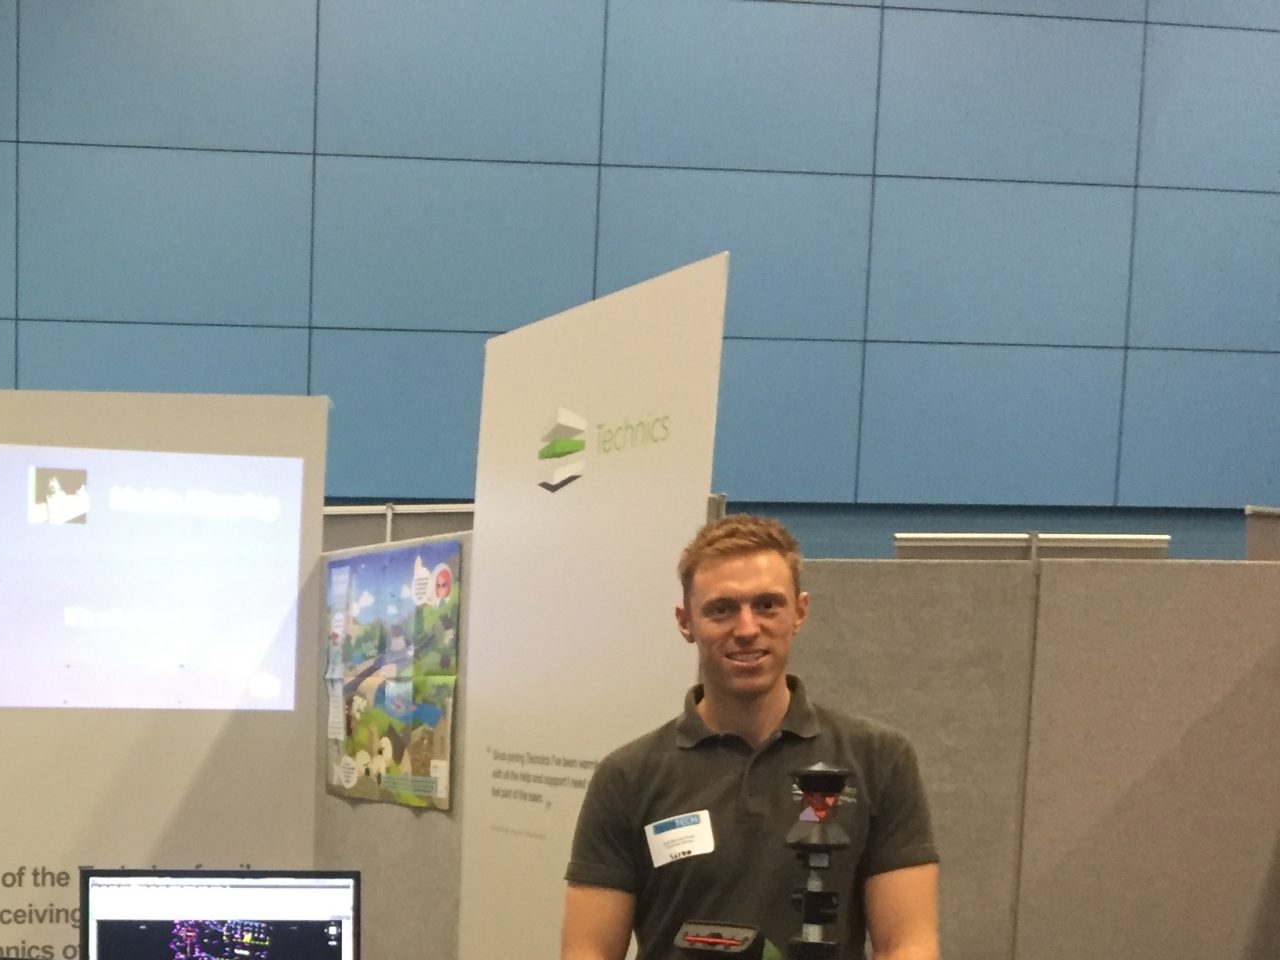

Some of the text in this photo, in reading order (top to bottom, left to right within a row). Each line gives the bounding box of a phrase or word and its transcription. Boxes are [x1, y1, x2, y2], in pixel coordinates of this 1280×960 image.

[595, 411, 670, 455] Technics
[1, 866, 26, 888] of
[32, 865, 70, 888] the
